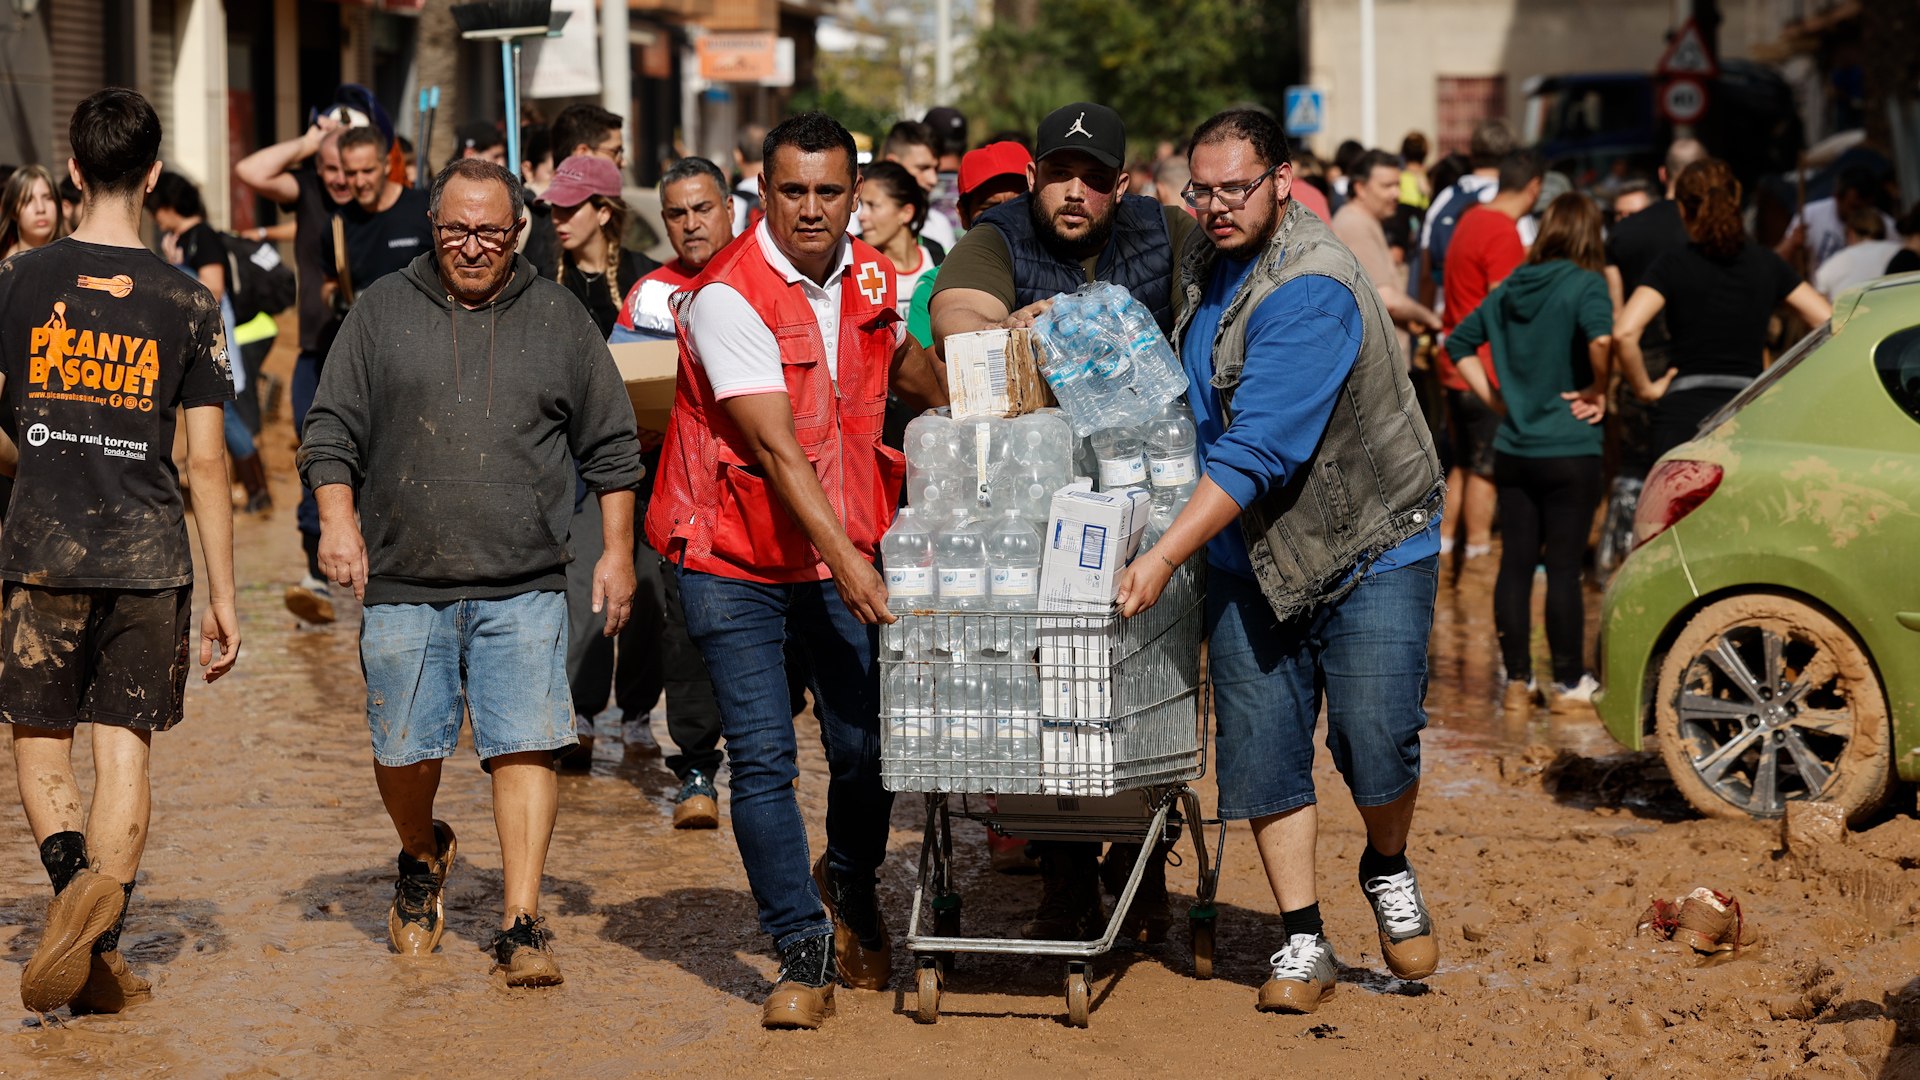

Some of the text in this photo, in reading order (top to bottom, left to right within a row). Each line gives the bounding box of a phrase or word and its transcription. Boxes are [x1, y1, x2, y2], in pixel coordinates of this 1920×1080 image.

[30, 327, 159, 369] PICANYA
[29, 356, 159, 396] BASQUET
[50, 429, 148, 451] caixa rul torrent
[103, 447, 146, 459] Fondo Social
